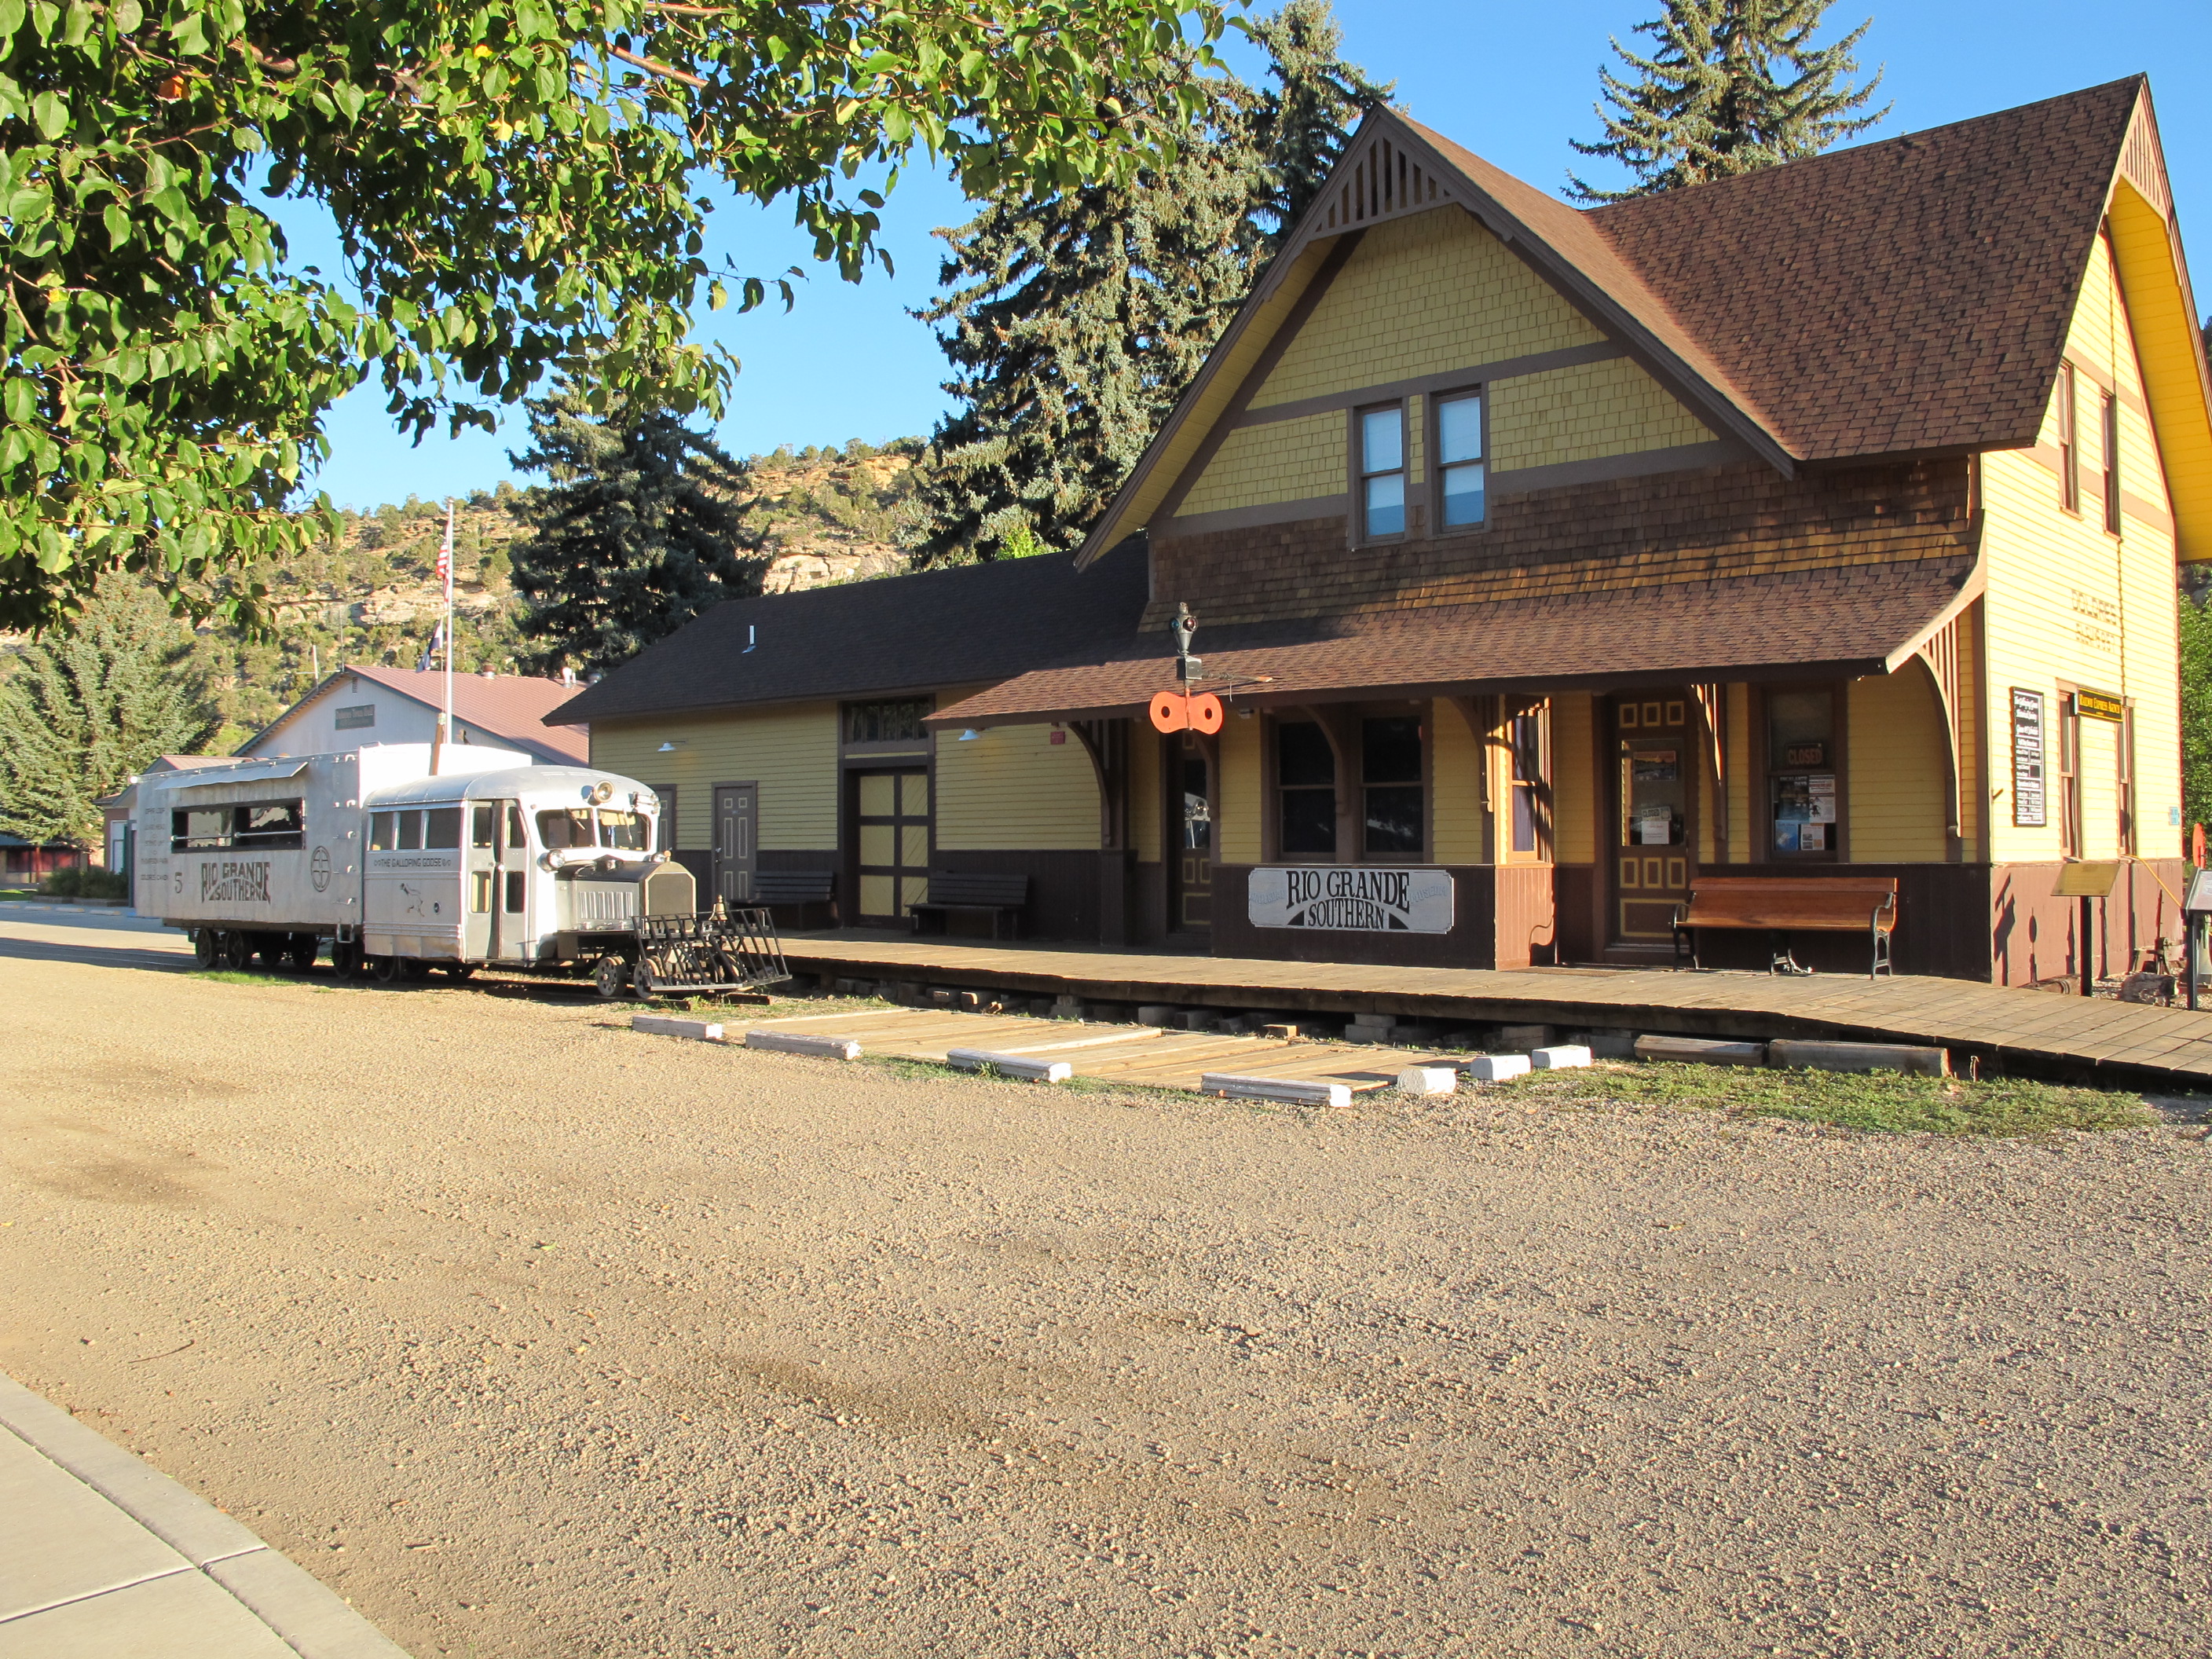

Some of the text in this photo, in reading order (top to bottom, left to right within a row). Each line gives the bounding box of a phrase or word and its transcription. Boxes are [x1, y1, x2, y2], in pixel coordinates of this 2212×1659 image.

[2071, 589, 2117, 626] DOLORES
[1788, 748, 1822, 765] CLOSED
[392, 858, 422, 867] GALLOPING
[423, 858, 441, 867] GOOSE
[174, 872, 183, 894] 5
[201, 861, 271, 905] RIO GRANDE
[214, 878, 262, 901] SOUTHERN
[1286, 870, 1410, 914] RIO GRANDE
[1308, 897, 1385, 929] SOUTHERN
